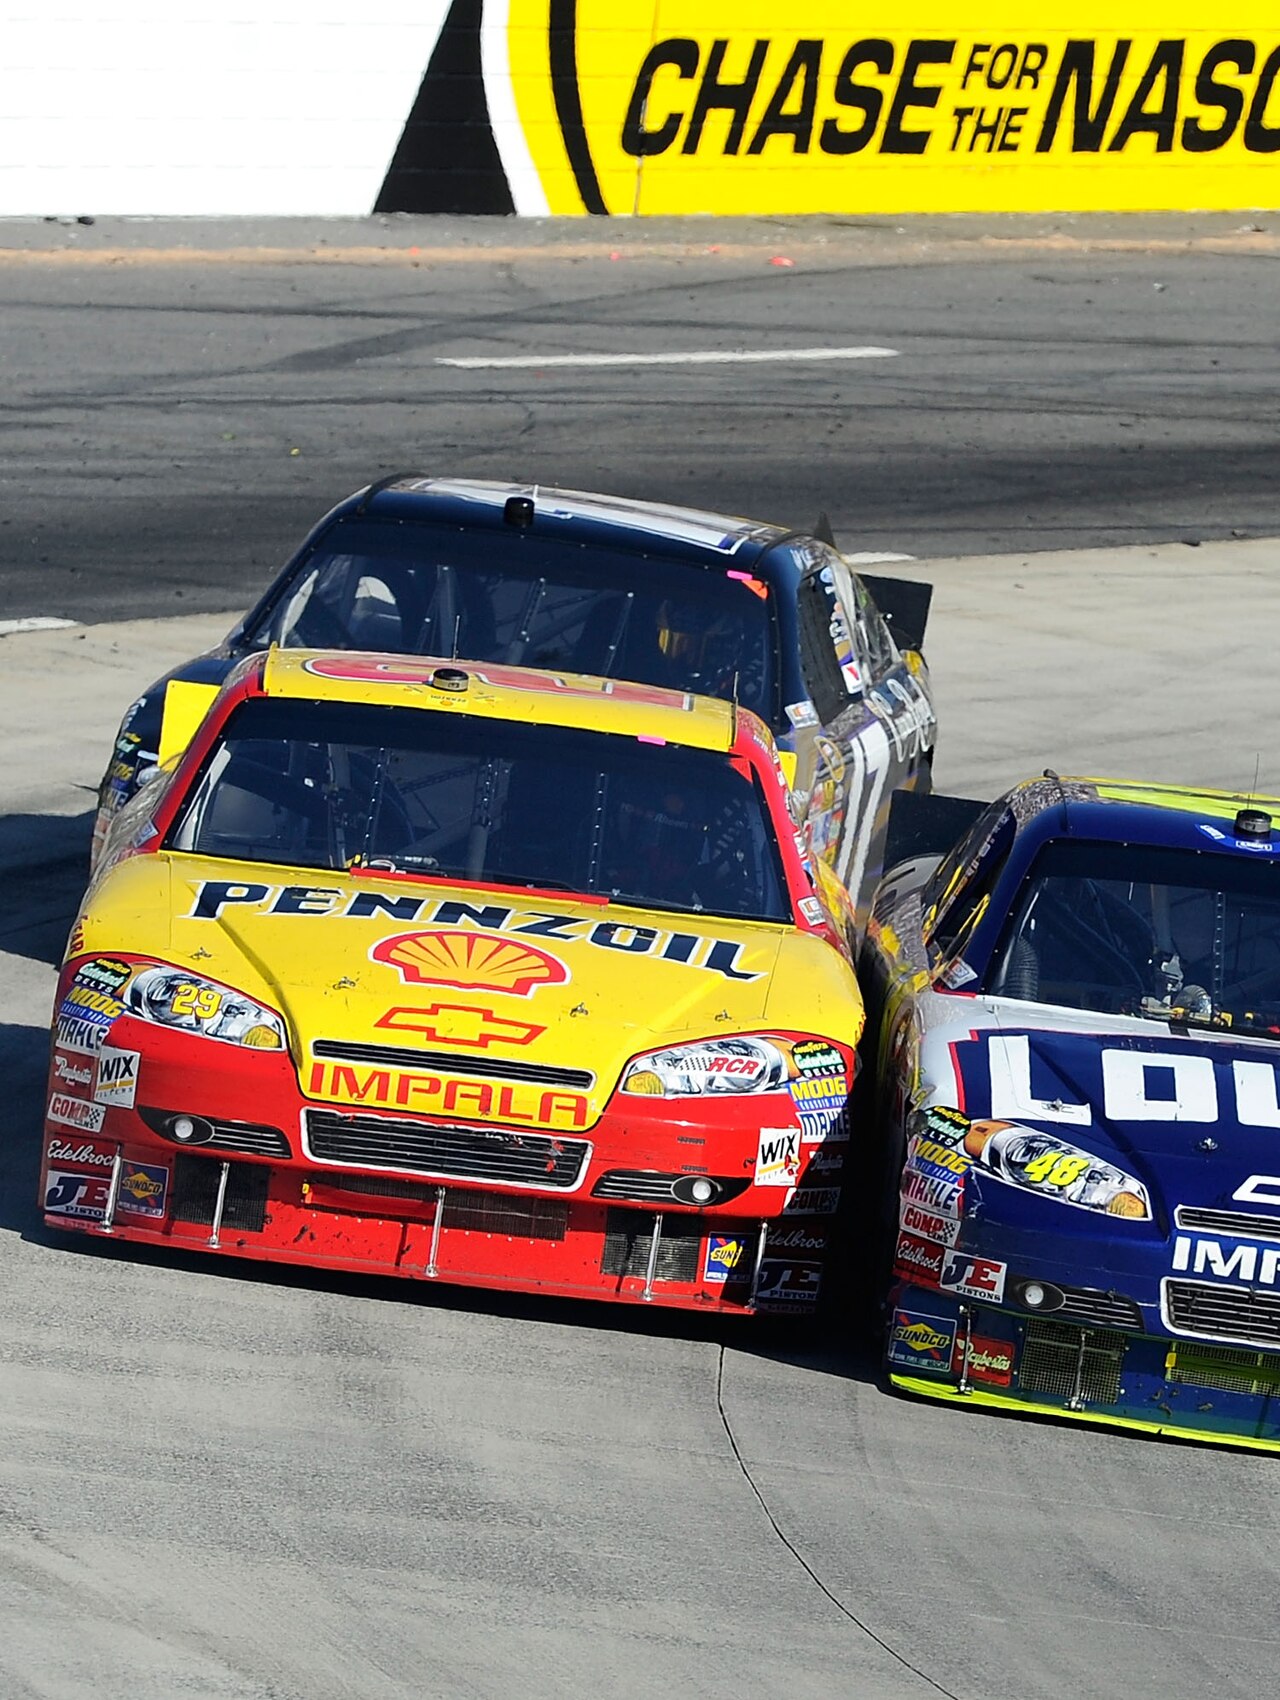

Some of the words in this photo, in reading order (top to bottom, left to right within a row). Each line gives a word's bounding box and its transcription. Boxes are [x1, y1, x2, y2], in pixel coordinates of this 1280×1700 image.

[962, 42, 1048, 91] FOR
[621, 38, 957, 157] CHASE
[952, 105, 1028, 154] THE
[176, 879, 770, 982] PENNZOIL
[73, 973, 117, 995] BELTS
[64, 985, 128, 1019] MOOG
[171, 982, 224, 1020] 29
[100, 1054, 135, 1083] WIX
[706, 1056, 760, 1076] RCR
[803, 1064, 846, 1078] BELTS
[308, 1062, 589, 1128] IMPALA
[789, 1076, 847, 1102] MOOG
[51, 1096, 91, 1122] COMP
[760, 1131, 799, 1166] WIX
[914, 1137, 975, 1176] MOOG
[1023, 1151, 1091, 1188] 48
[45, 1175, 112, 1208] JE
[121, 1177, 164, 1195] SUNOCO
[63, 1205, 107, 1219] PISTO
[903, 1206, 945, 1234] COMP
[941, 1254, 1003, 1292] JE
[769, 1289, 817, 1299] PISTON
[955, 1283, 1002, 1303] PISTONS
[894, 1327, 951, 1348] SUNOCO
